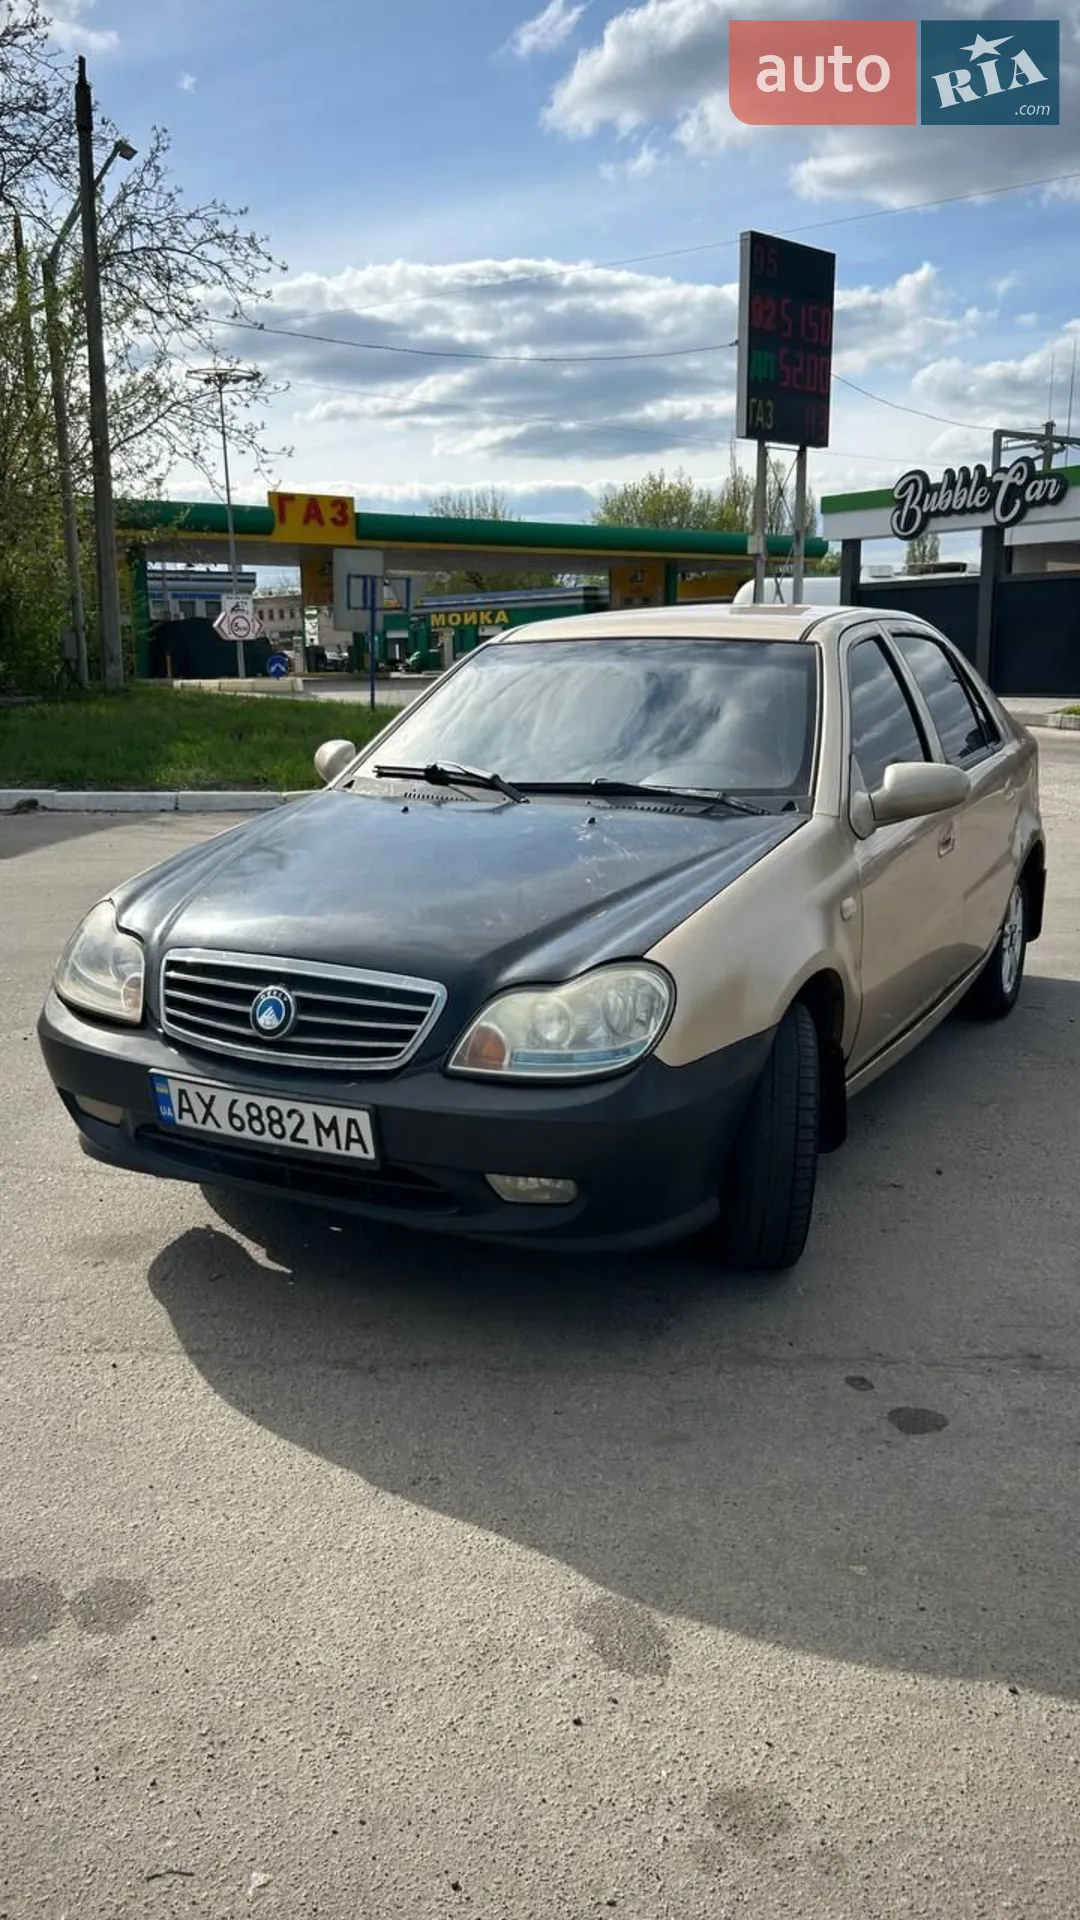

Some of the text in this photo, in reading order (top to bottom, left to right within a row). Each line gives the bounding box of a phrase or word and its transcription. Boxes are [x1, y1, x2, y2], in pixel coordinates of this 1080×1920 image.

[749, 398, 775, 430] ГАЗ
[277, 494, 350, 528] ГАЗ
[891, 460, 1061, 536] Bubble Car
